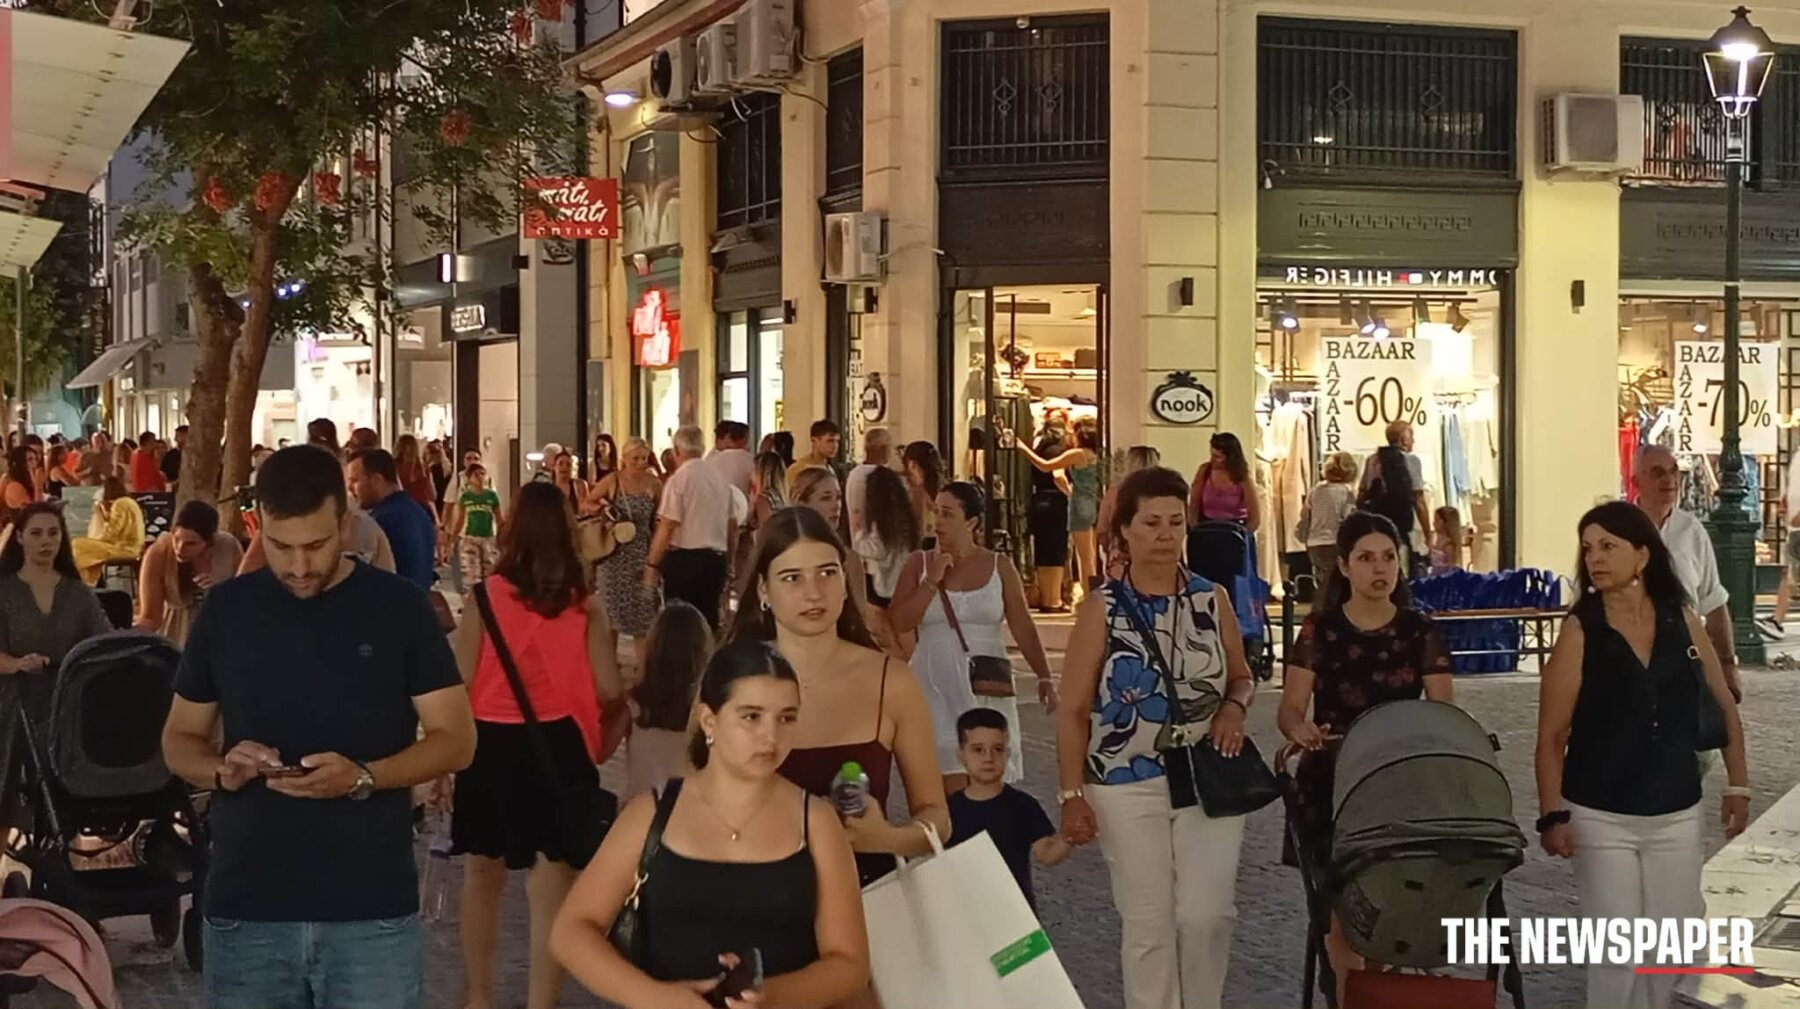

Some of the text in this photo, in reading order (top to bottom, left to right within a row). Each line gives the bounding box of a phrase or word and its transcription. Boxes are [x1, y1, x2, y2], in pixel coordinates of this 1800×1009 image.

[1326, 341, 1415, 360] BAZAAR
[1680, 345, 1762, 364] BAZAR
[1161, 393, 1208, 412] nook
[1344, 376, 1427, 426] -60%
